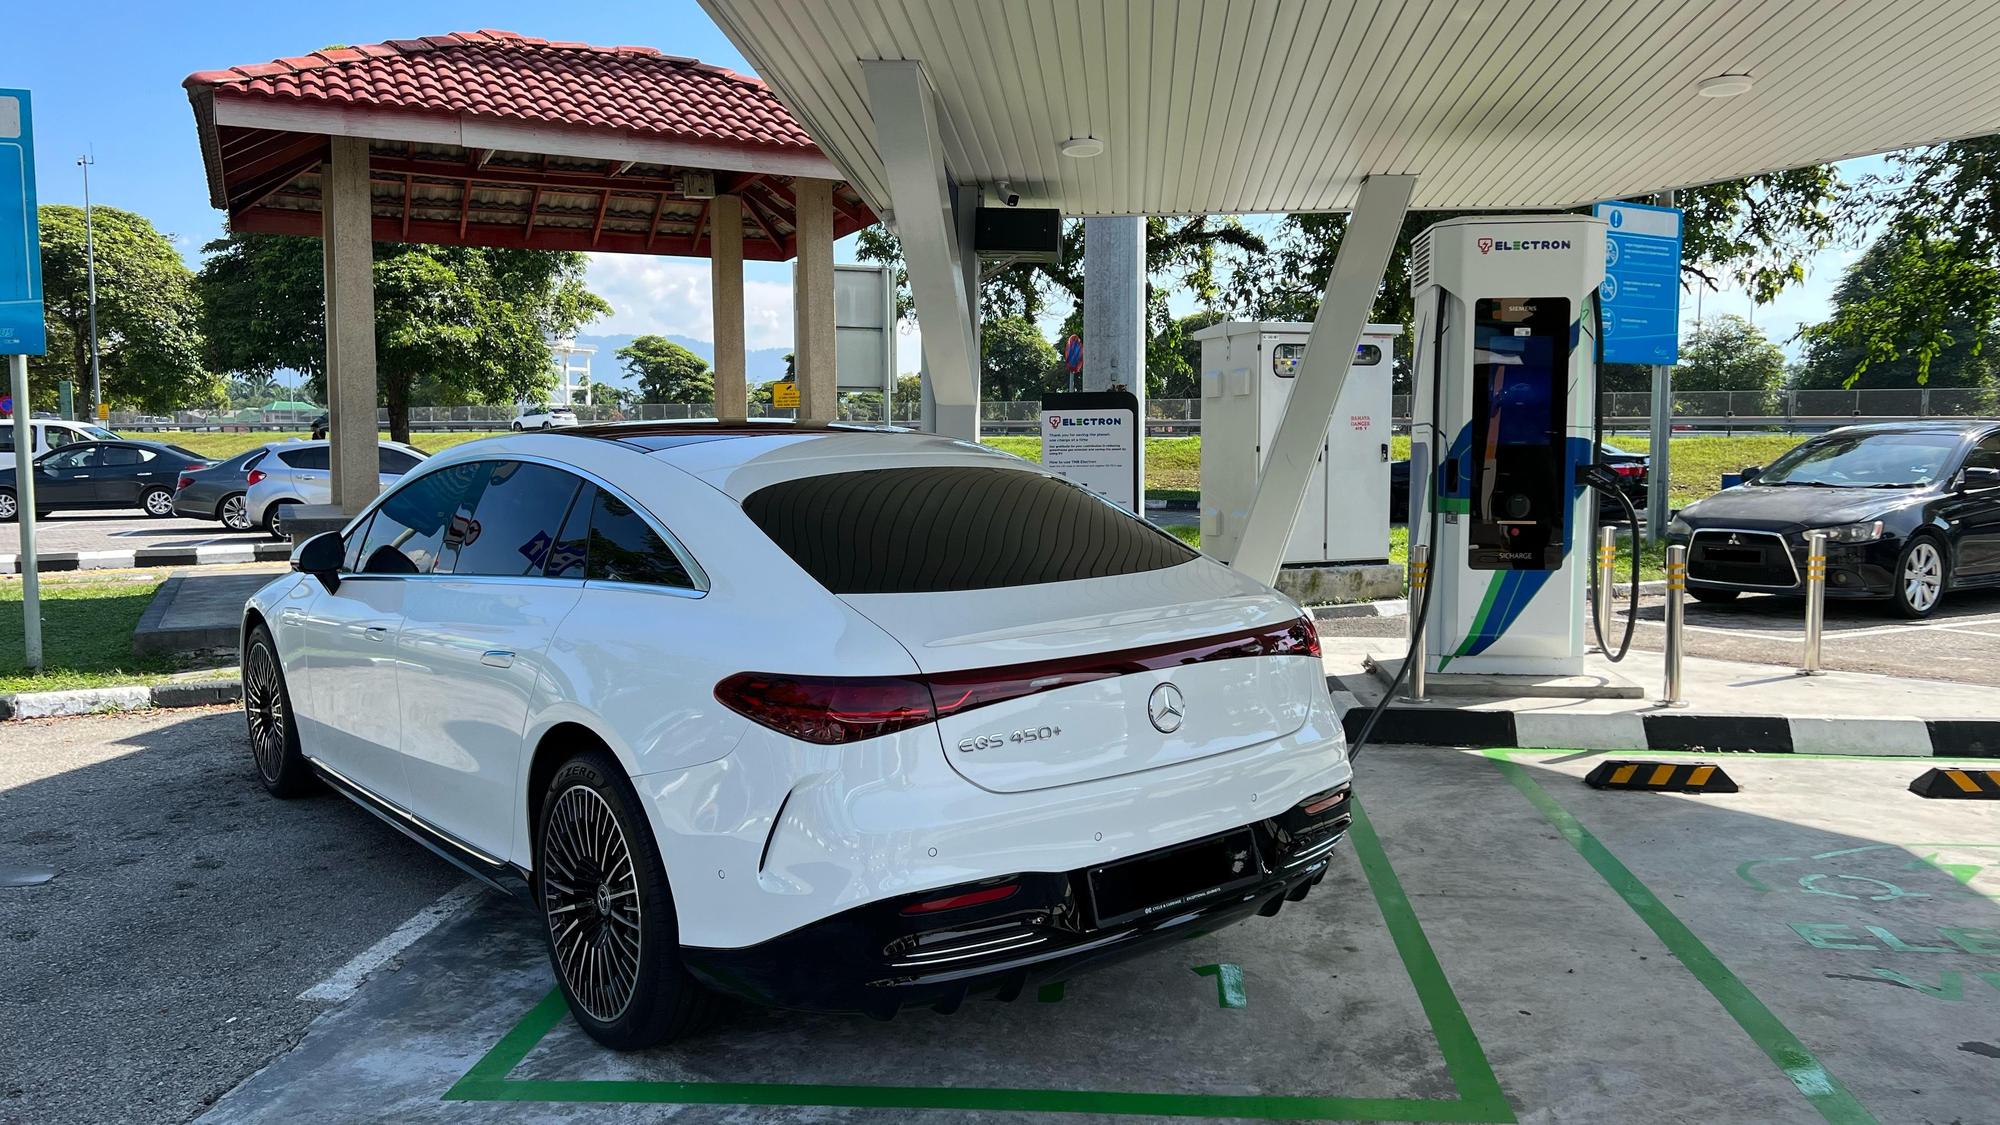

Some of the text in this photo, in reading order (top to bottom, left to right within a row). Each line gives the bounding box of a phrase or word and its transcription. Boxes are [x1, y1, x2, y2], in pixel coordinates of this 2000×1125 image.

[1495, 240, 1571, 250] ELECTRON
[1062, 418, 1121, 426] ELECTRON
[959, 726, 1062, 753] EQS 450+
[565, 765, 597, 780] ZERO
